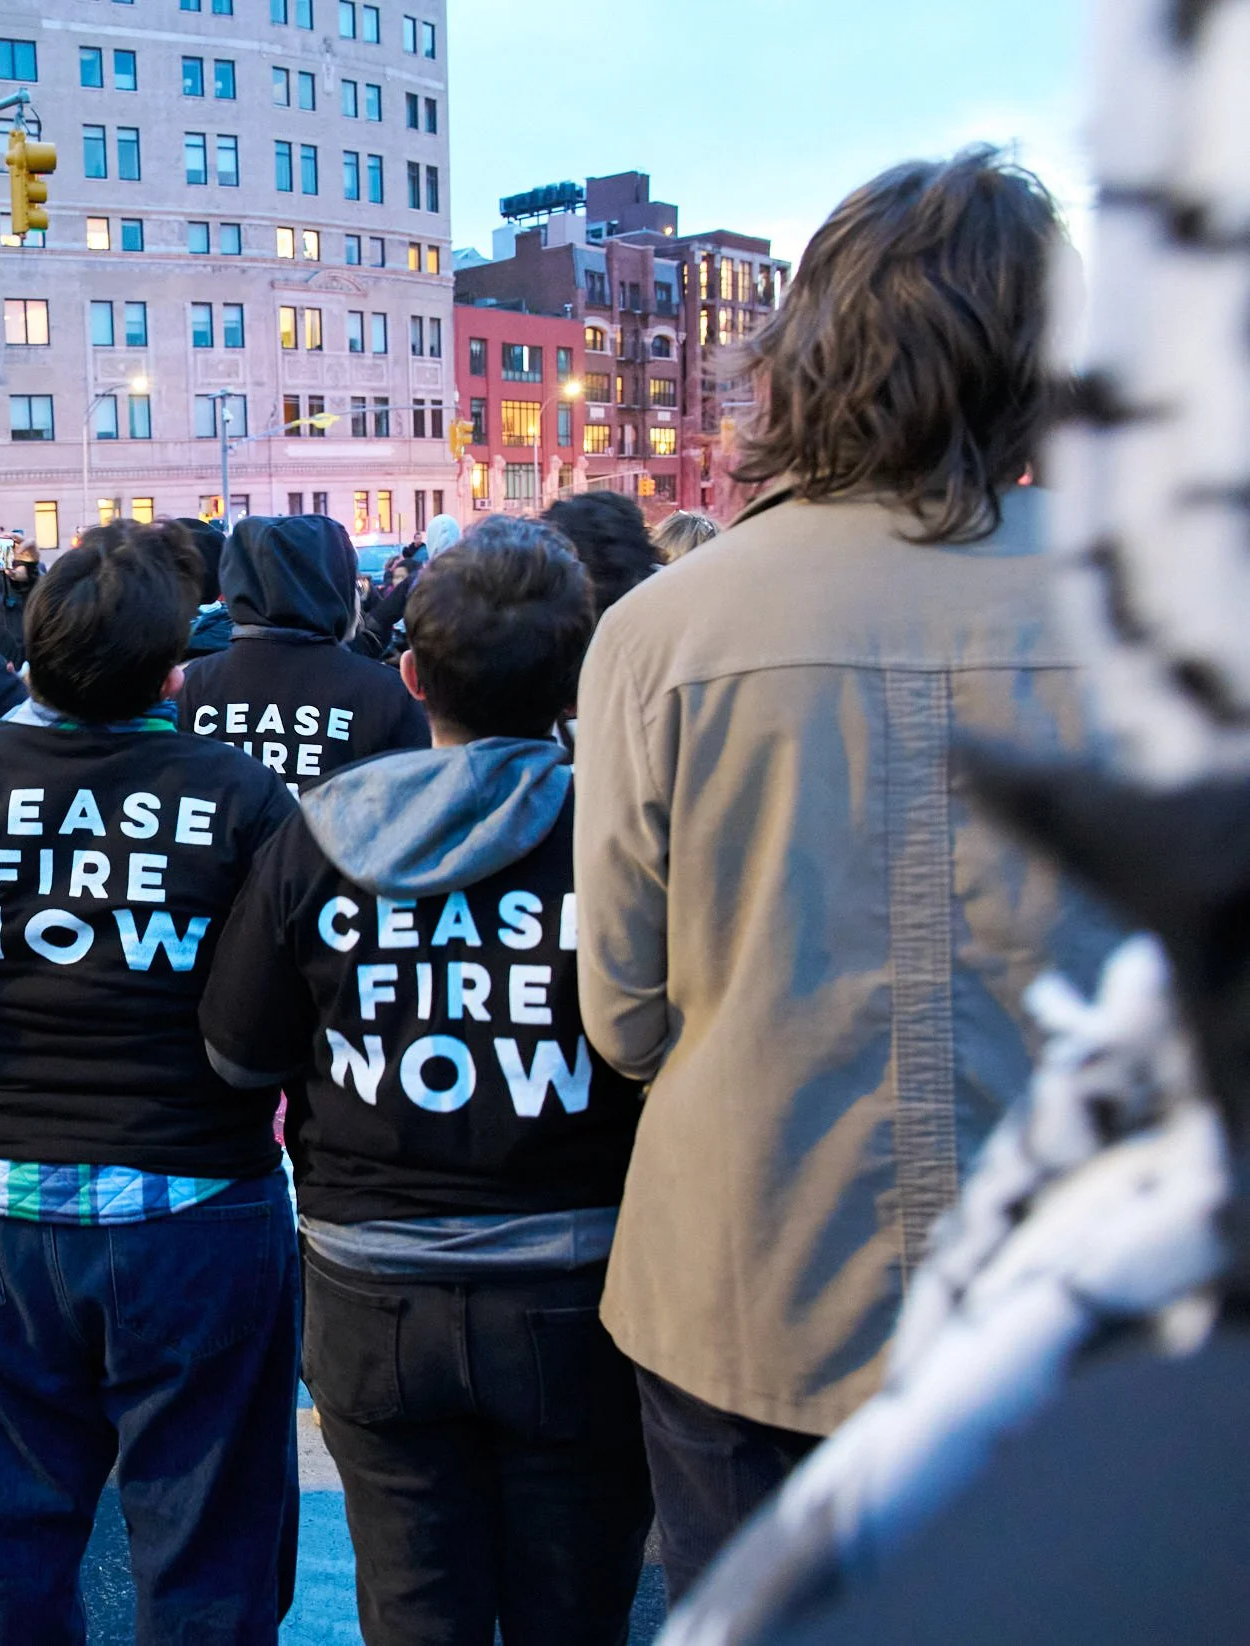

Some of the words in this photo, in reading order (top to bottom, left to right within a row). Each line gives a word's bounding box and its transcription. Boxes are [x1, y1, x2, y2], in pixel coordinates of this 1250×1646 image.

[194, 703, 354, 741] CEASE
[223, 741, 323, 776] RE
[357, 961, 552, 1025] FIRE
[326, 1028, 593, 1118] NOW
